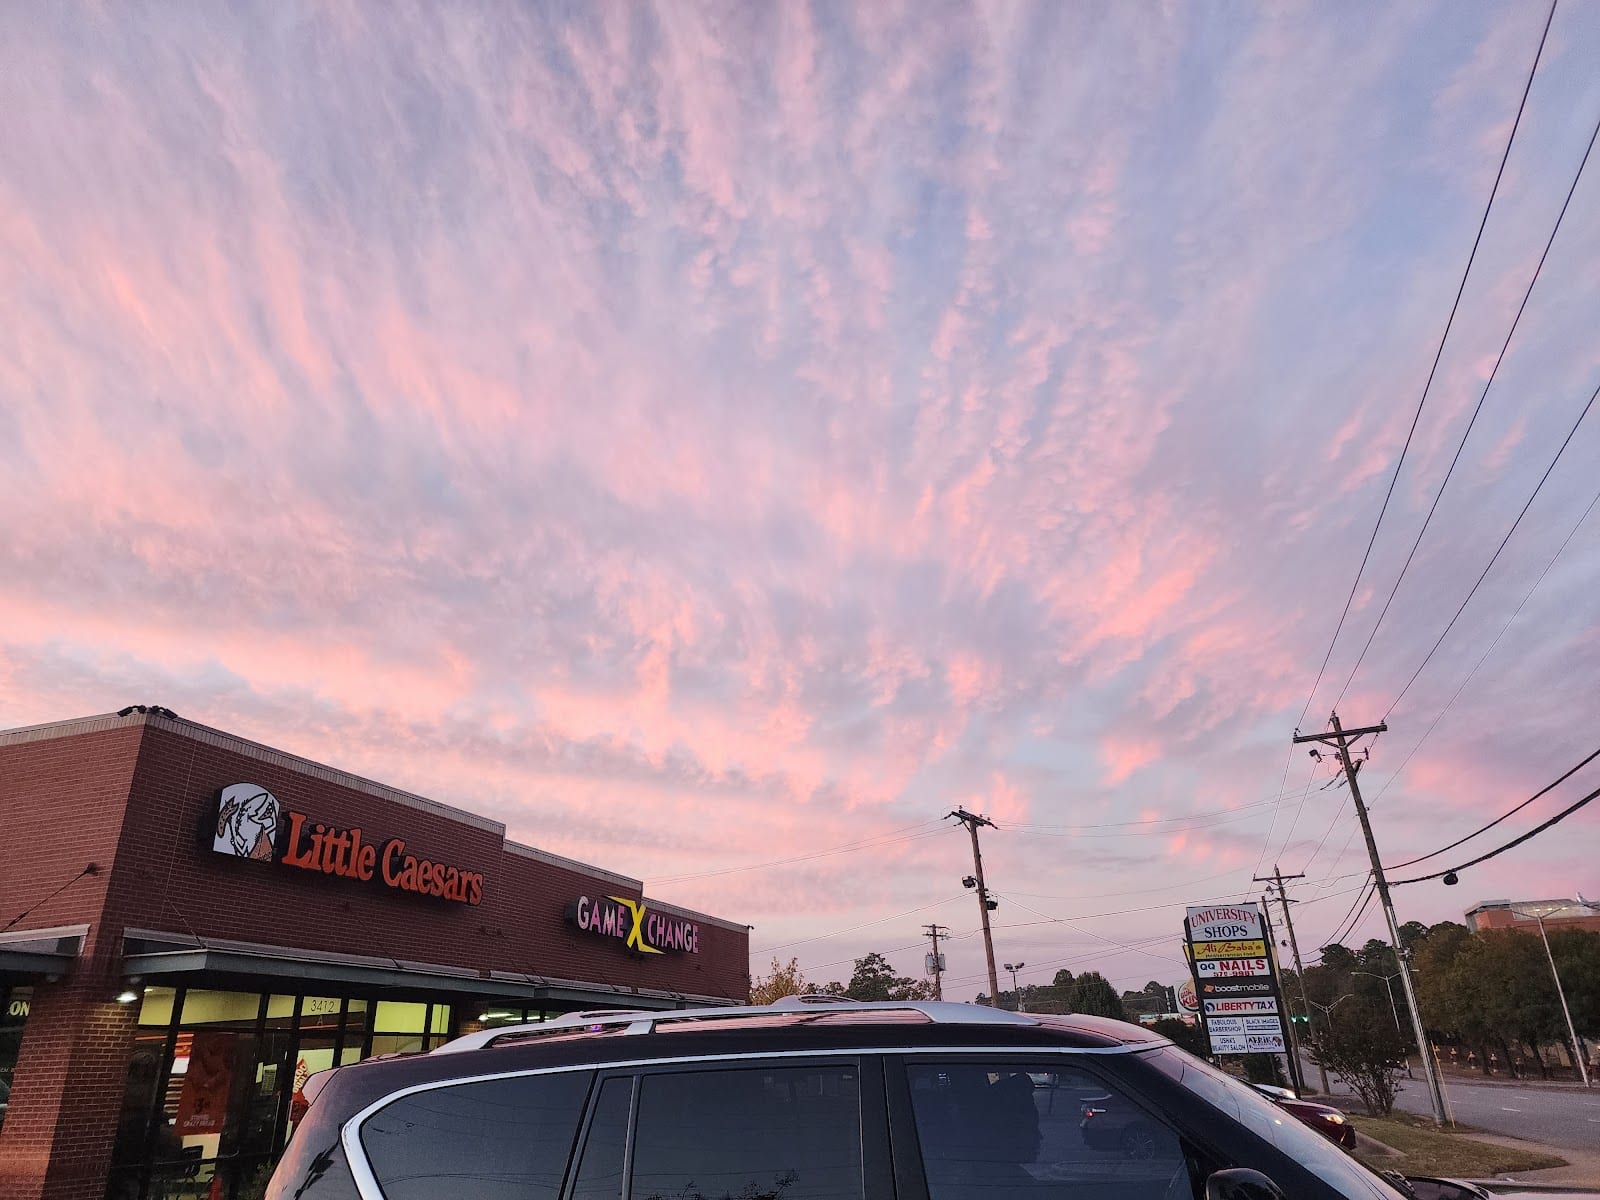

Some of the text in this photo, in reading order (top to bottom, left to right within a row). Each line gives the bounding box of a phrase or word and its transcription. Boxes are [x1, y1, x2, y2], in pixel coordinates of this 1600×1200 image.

[281, 811, 484, 906] Little Caesars
[577, 895, 625, 938] GAME
[647, 913, 699, 954] CHANGE
[1191, 908, 1256, 928] UNIVERSITY
[1204, 925, 1248, 939] SHOPS
[1197, 942, 1262, 955] Ali Baba's
[1219, 959, 1266, 971] NAILS
[311, 999, 335, 1013] 3412
